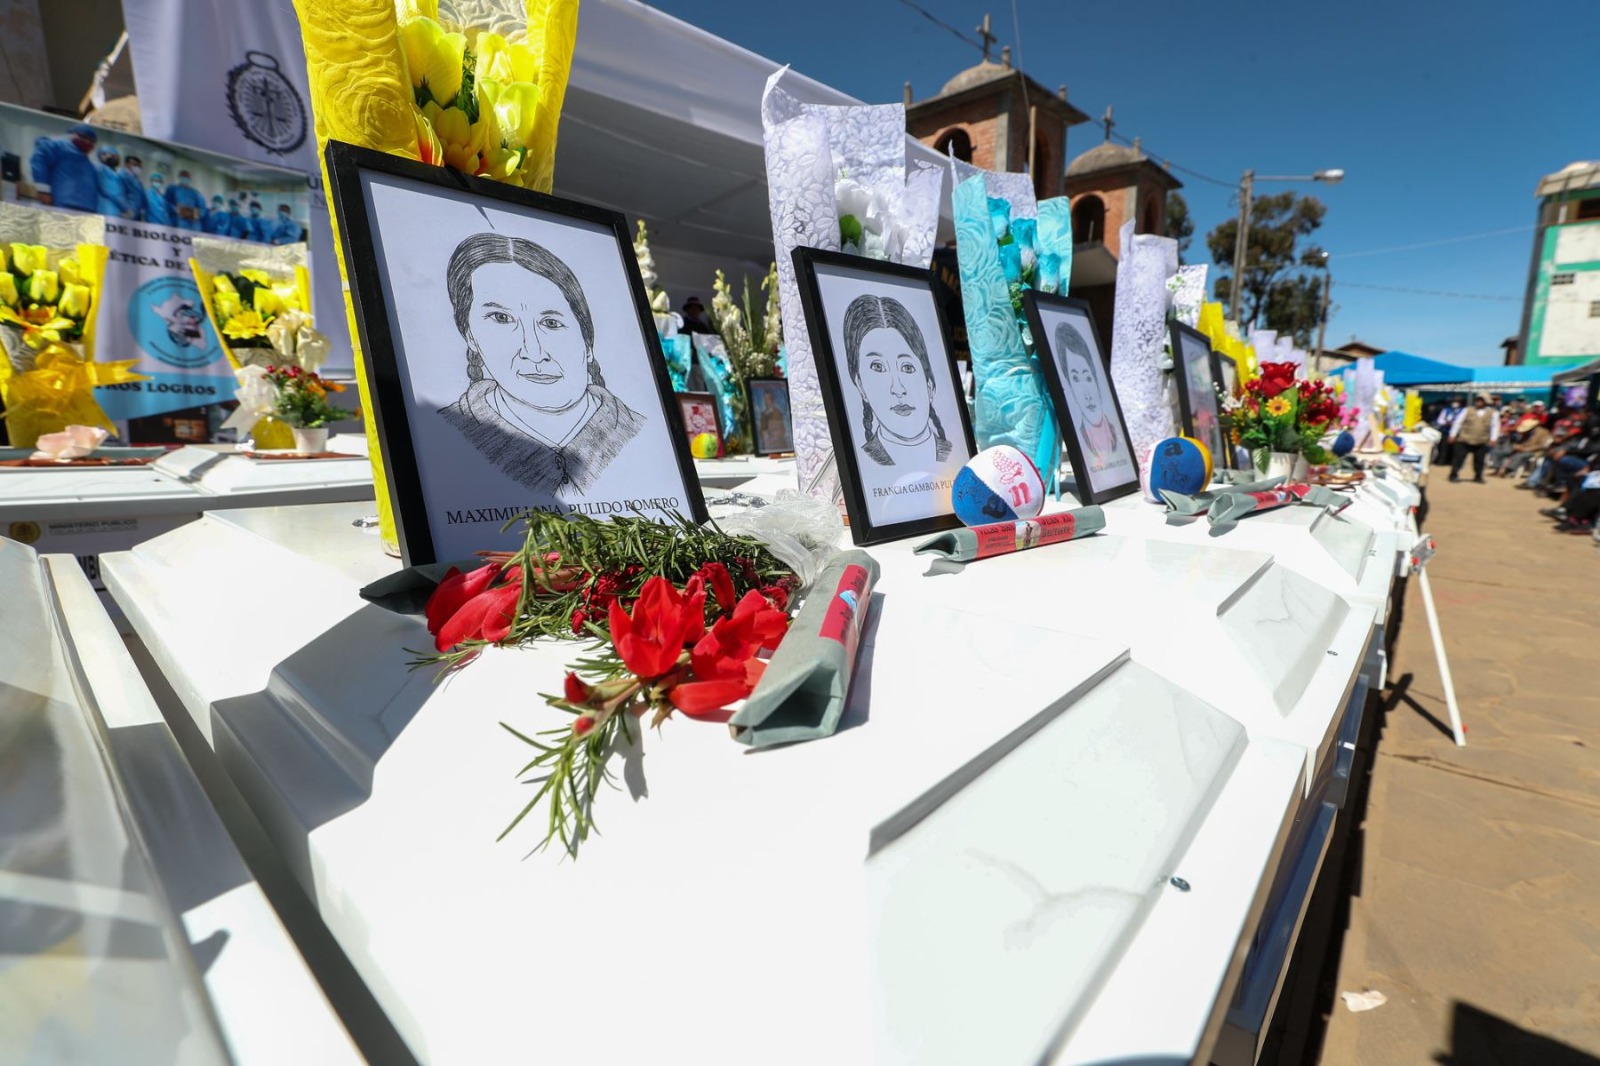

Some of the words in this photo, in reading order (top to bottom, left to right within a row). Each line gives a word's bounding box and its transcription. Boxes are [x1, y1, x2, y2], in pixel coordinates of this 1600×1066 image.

[106, 223, 128, 235] DE
[132, 228, 193, 245] BIOLOG
[172, 247, 183, 257] Y
[109, 250, 160, 267] ÉTICA
[165, 259, 186, 270] DE
[147, 383, 216, 395] LOGROS
[1165, 442, 1184, 456] a
[908, 482, 940, 493] GAMBOA
[446, 504, 564, 524] MAXIMILINA
[568, 501, 622, 515] PULIDO
[624, 497, 679, 511] ROMERO
